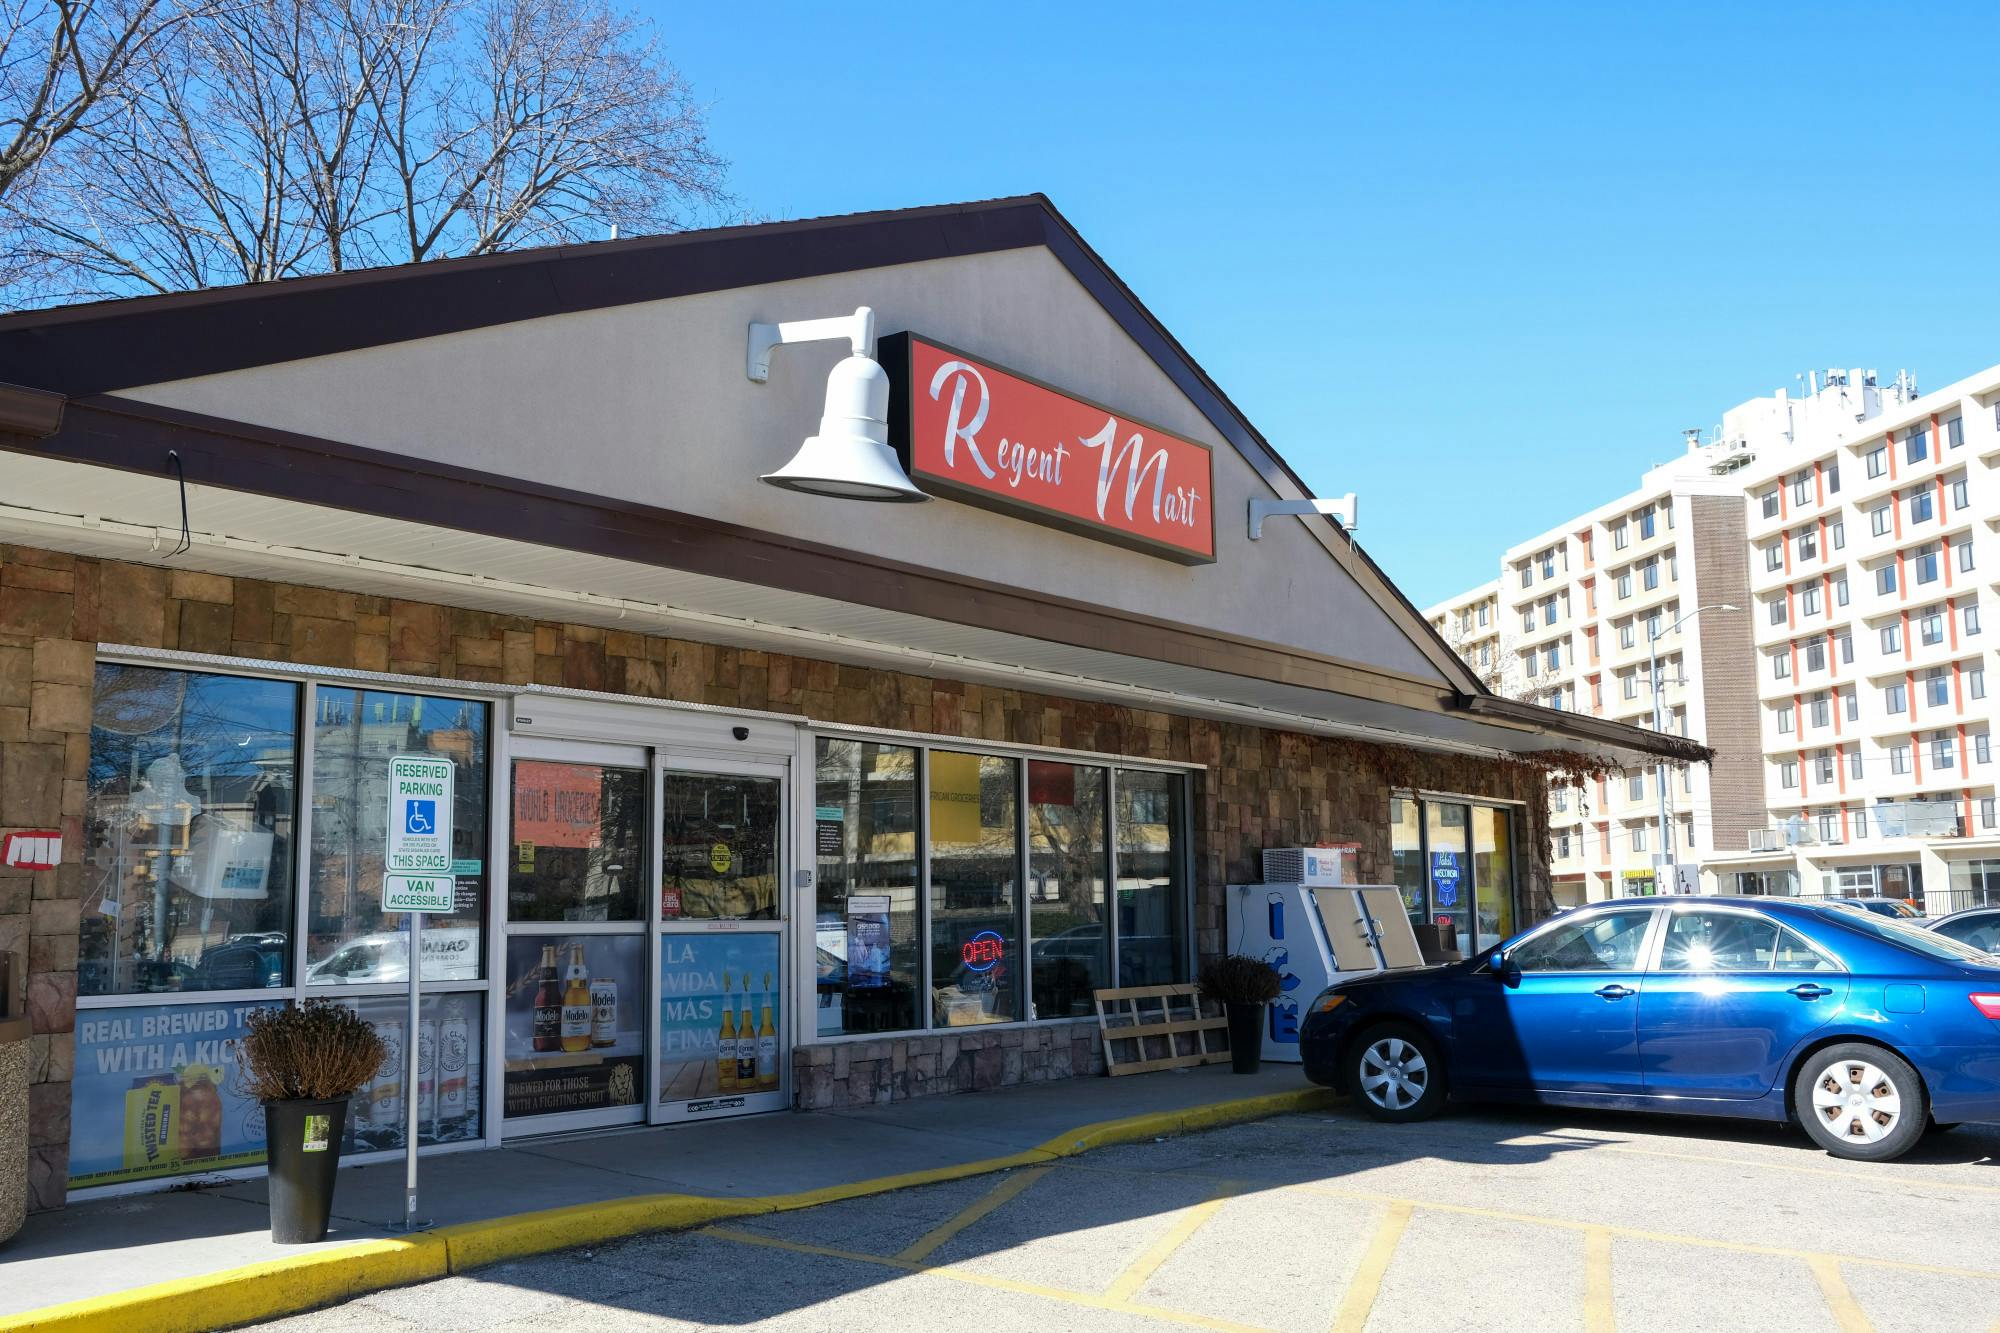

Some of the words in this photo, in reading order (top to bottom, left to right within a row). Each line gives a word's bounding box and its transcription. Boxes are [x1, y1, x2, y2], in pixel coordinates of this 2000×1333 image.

[929, 360, 1071, 488] Regent
[1078, 416, 1201, 527] Mart
[395, 764, 448, 779] RESERVED
[399, 781, 443, 796] PARKING
[392, 855, 414, 867] THIS
[415, 855, 446, 867] SPACE
[406, 879, 435, 893] VAN
[390, 894, 449, 906] ACCESSIBLE
[667, 943, 696, 964] LA
[962, 938, 1003, 963] OPEN
[1264, 892, 1302, 1044] ICE
[667, 971, 719, 993] VIDA
[592, 992, 616, 1006] Modelo
[666, 997, 713, 1022] MÁS
[535, 1008, 559, 1021] Modelo
[565, 1008, 588, 1021] Modelo
[81, 1018, 137, 1045] REAL
[142, 1009, 229, 1038] BREWED
[96, 1044, 165, 1074] WITH
[170, 1042, 188, 1068] A
[508, 1080, 544, 1096] BREWED
[545, 1079, 561, 1092] FOR
[563, 1076, 589, 1091] THOSE
[146, 1090, 162, 1111] TEA
[508, 1097, 531, 1112] WITH
[532, 1097, 538, 1110] A
[539, 1093, 578, 1108] FIGHTING
[579, 1089, 605, 1105] SPIRIT
[144, 1112, 160, 1162] TWISTED
